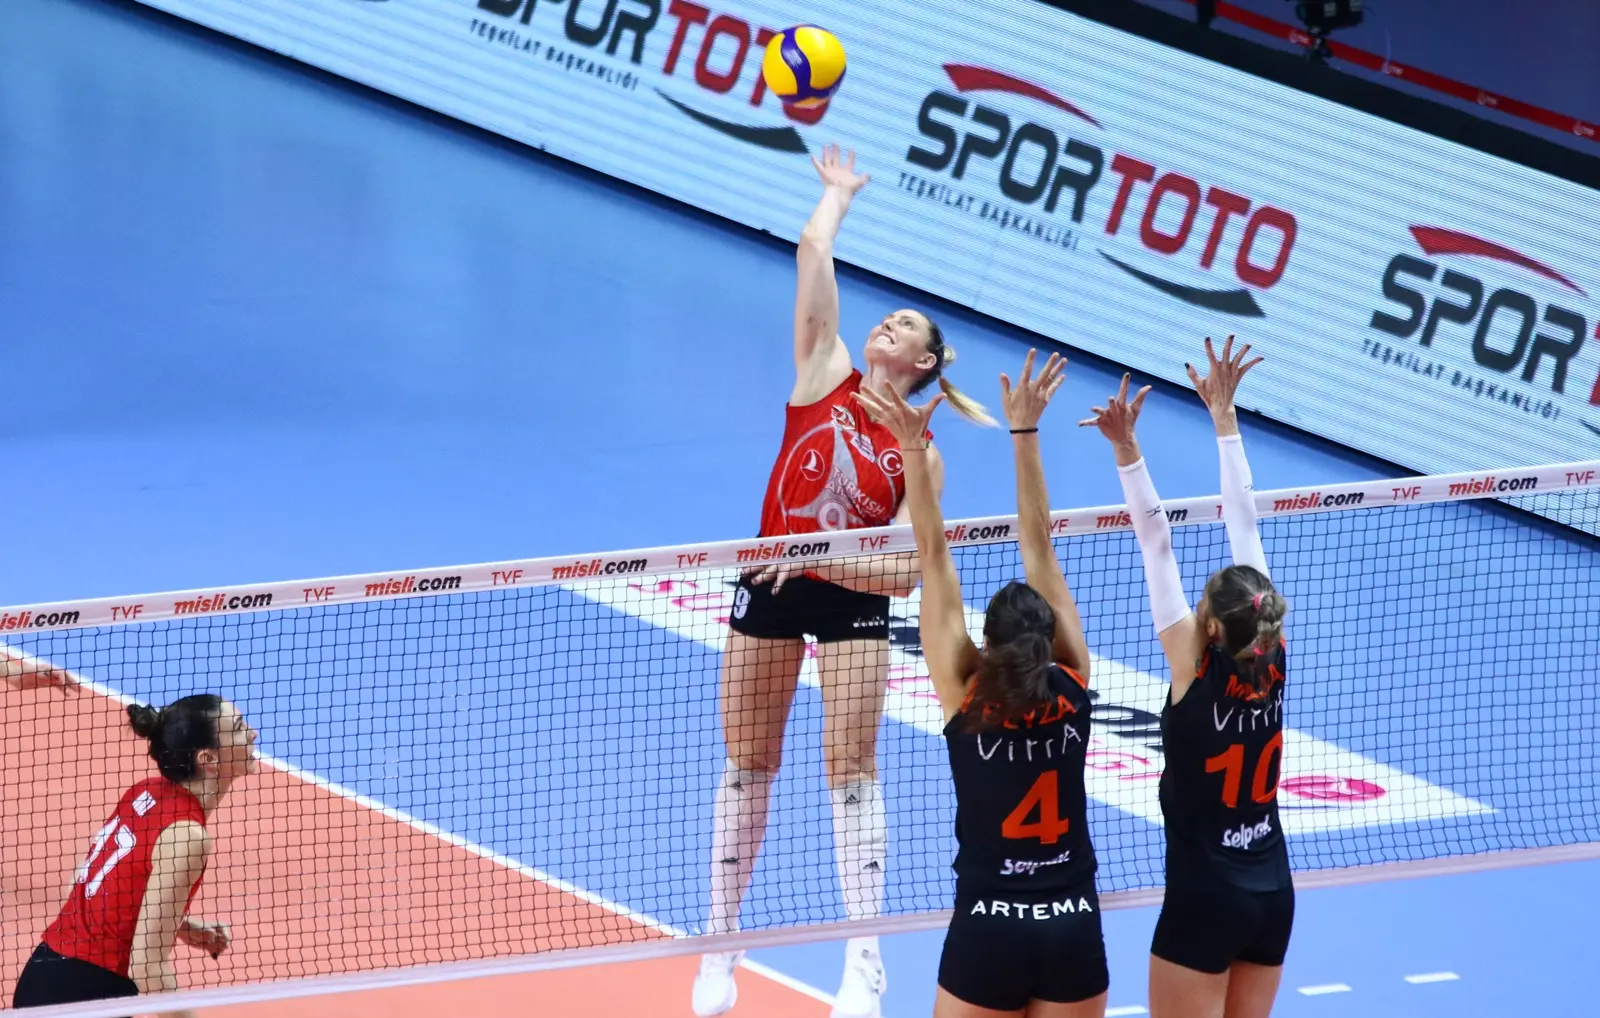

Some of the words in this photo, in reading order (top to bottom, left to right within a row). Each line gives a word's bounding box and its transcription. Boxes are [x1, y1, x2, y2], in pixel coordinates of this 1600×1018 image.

[833, 464, 886, 515] TURKISH
[0, 611, 80, 630] isli.com
[111, 605, 143, 620] TVF
[174, 592, 272, 615] misli.com
[303, 587, 334, 602] TVF
[365, 575, 461, 596] misli.com
[492, 570, 522, 585] TVF
[552, 557, 648, 579] misli.com
[677, 553, 707, 567] TVF
[736, 541, 829, 563] misli.com
[859, 536, 889, 551] TVF
[944, 524, 1010, 541] sli.com
[1050, 519, 1069, 533] VF
[1274, 490, 1364, 511] misli.com
[1392, 486, 1421, 501] TVF
[1449, 476, 1538, 496] misli.com
[1565, 471, 1595, 485] TVF
[734, 587, 751, 619] 9
[1205, 733, 1283, 808] 10
[1002, 769, 1070, 845] 4
[971, 897, 1093, 920] ARTEMA
